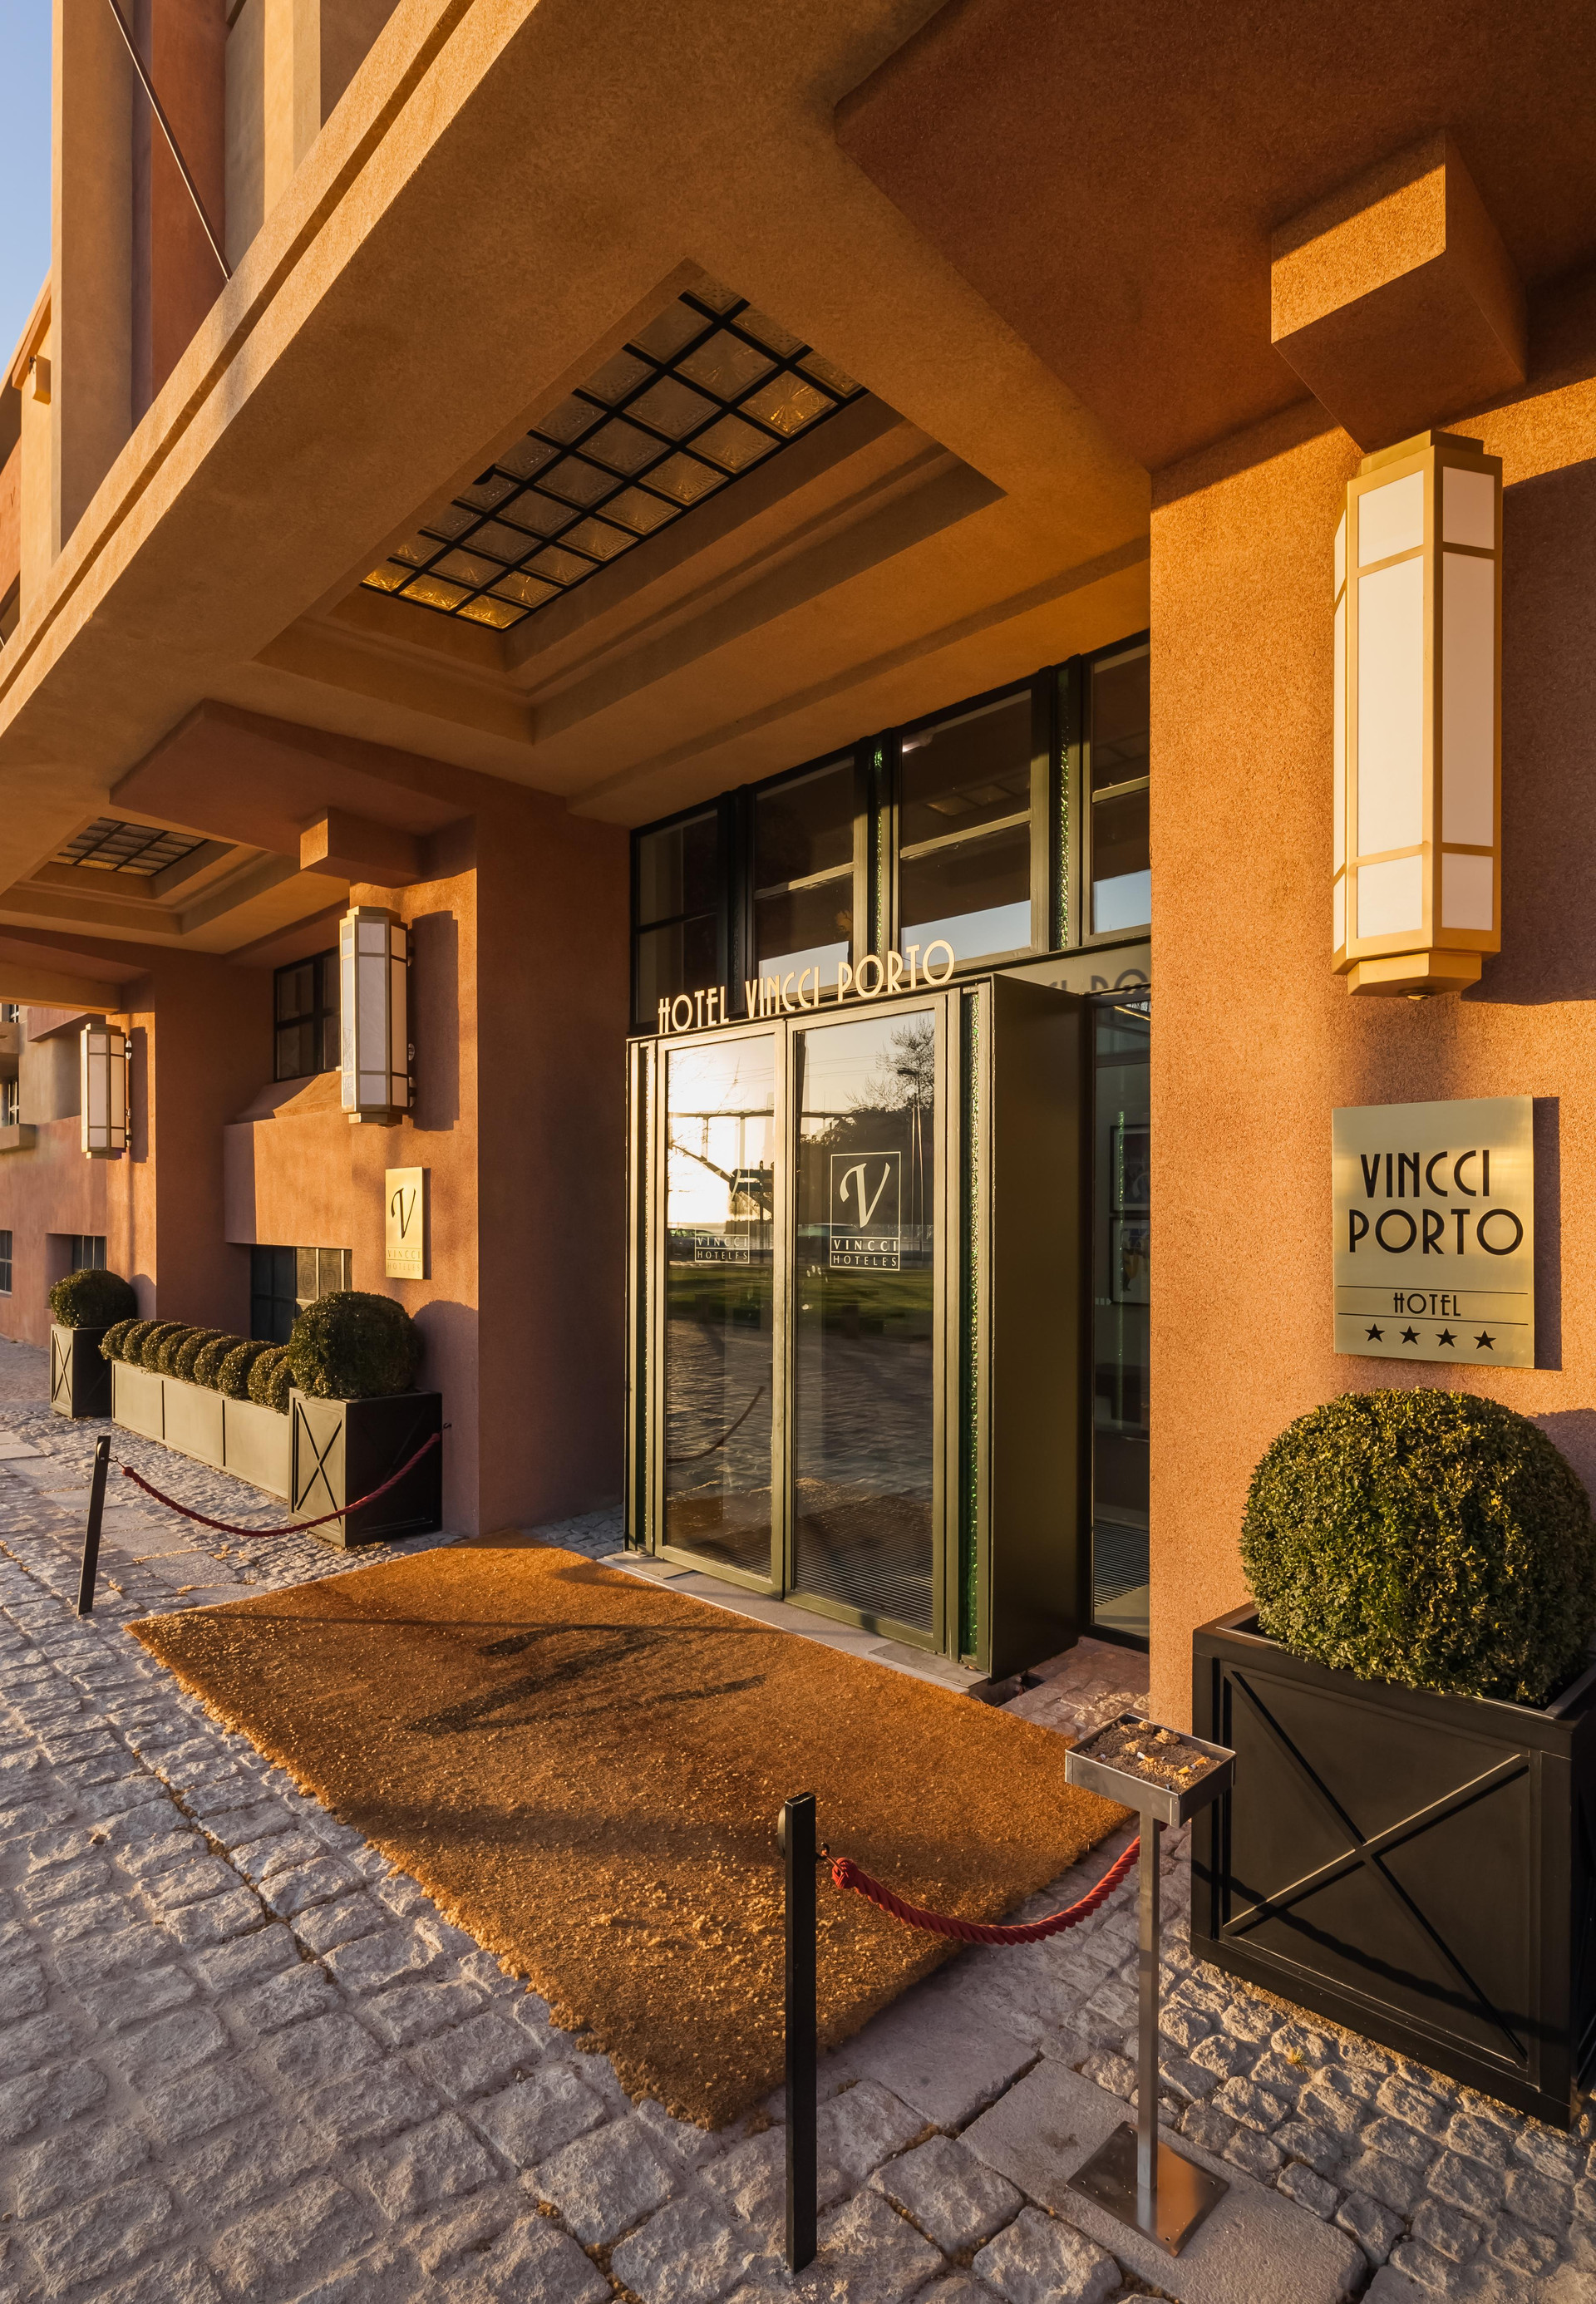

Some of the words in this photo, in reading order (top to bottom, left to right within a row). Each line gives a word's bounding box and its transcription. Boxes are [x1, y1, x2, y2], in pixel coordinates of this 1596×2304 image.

[658, 986, 729, 1034] HOTEL
[746, 966, 820, 1019] VINCCI
[838, 939, 955, 1002] PORTO
[1360, 1150, 1490, 1198] VINCCI
[840, 1162, 891, 1228] V
[391, 1188, 416, 1239] V
[697, 1236, 746, 1247] VINCCI
[1348, 1209, 1524, 1256] PORTO
[387, 1249, 421, 1259] VINCCI
[834, 1239, 897, 1252] VINCCI
[387, 1262, 421, 1272] HOTELES
[833, 1255, 897, 1267] HOTELES
[1393, 1292, 1461, 1317] HOTEL
